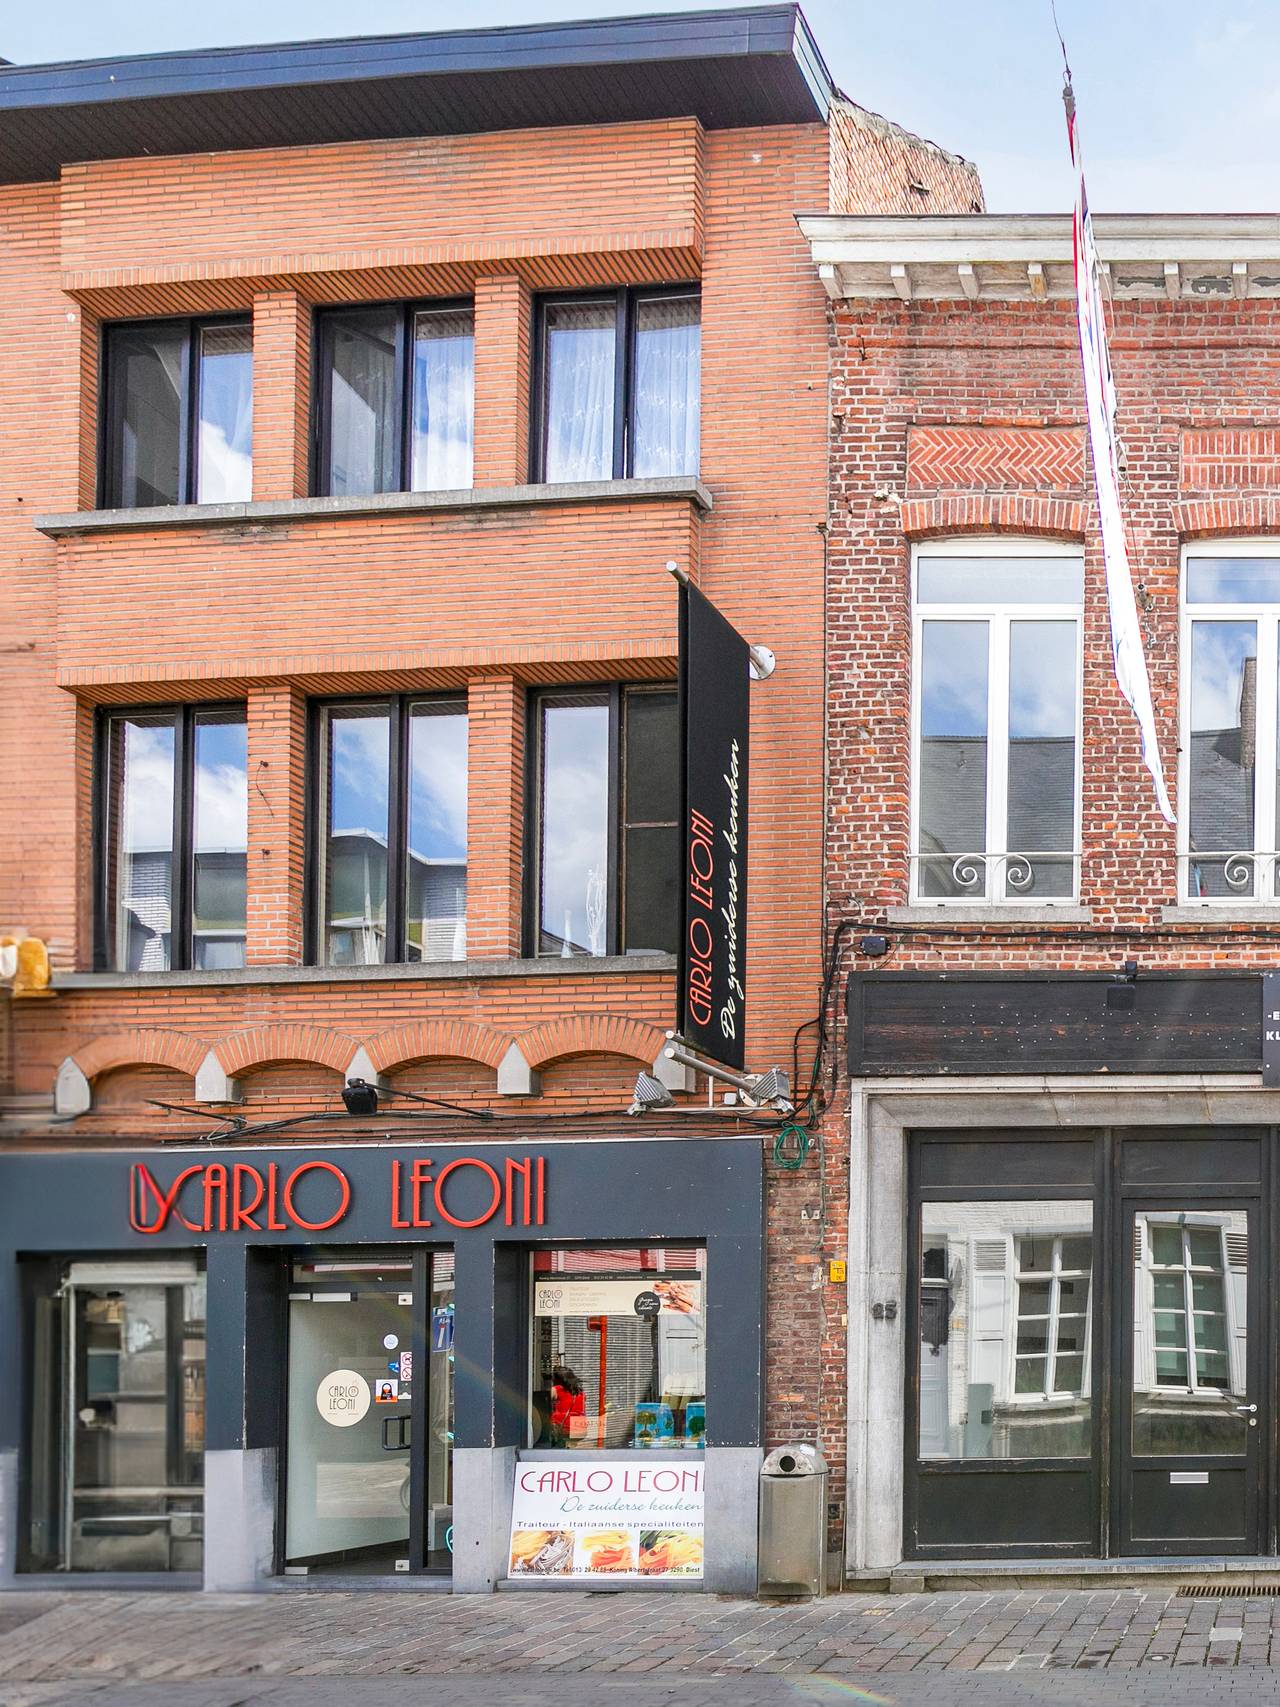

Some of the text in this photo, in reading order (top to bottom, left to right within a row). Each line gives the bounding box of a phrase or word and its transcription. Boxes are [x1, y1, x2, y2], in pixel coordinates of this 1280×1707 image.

[720, 737, 745, 1040] De zuiderse keuken
[690, 808, 714, 1026] CARLO LEONI
[391, 1156, 545, 1229] LEONI
[872, 1300, 897, 1320] 25
[328, 1385, 360, 1398] CARLO
[329, 1398, 356, 1410] LEONI
[520, 1470, 613, 1493] CARLO
[560, 1495, 704, 1513] De zuiderse keuken
[517, 1520, 560, 1528] Traiteur
[569, 1520, 624, 1528] Italiaanse
[627, 1520, 704, 1529] specialiteiten
